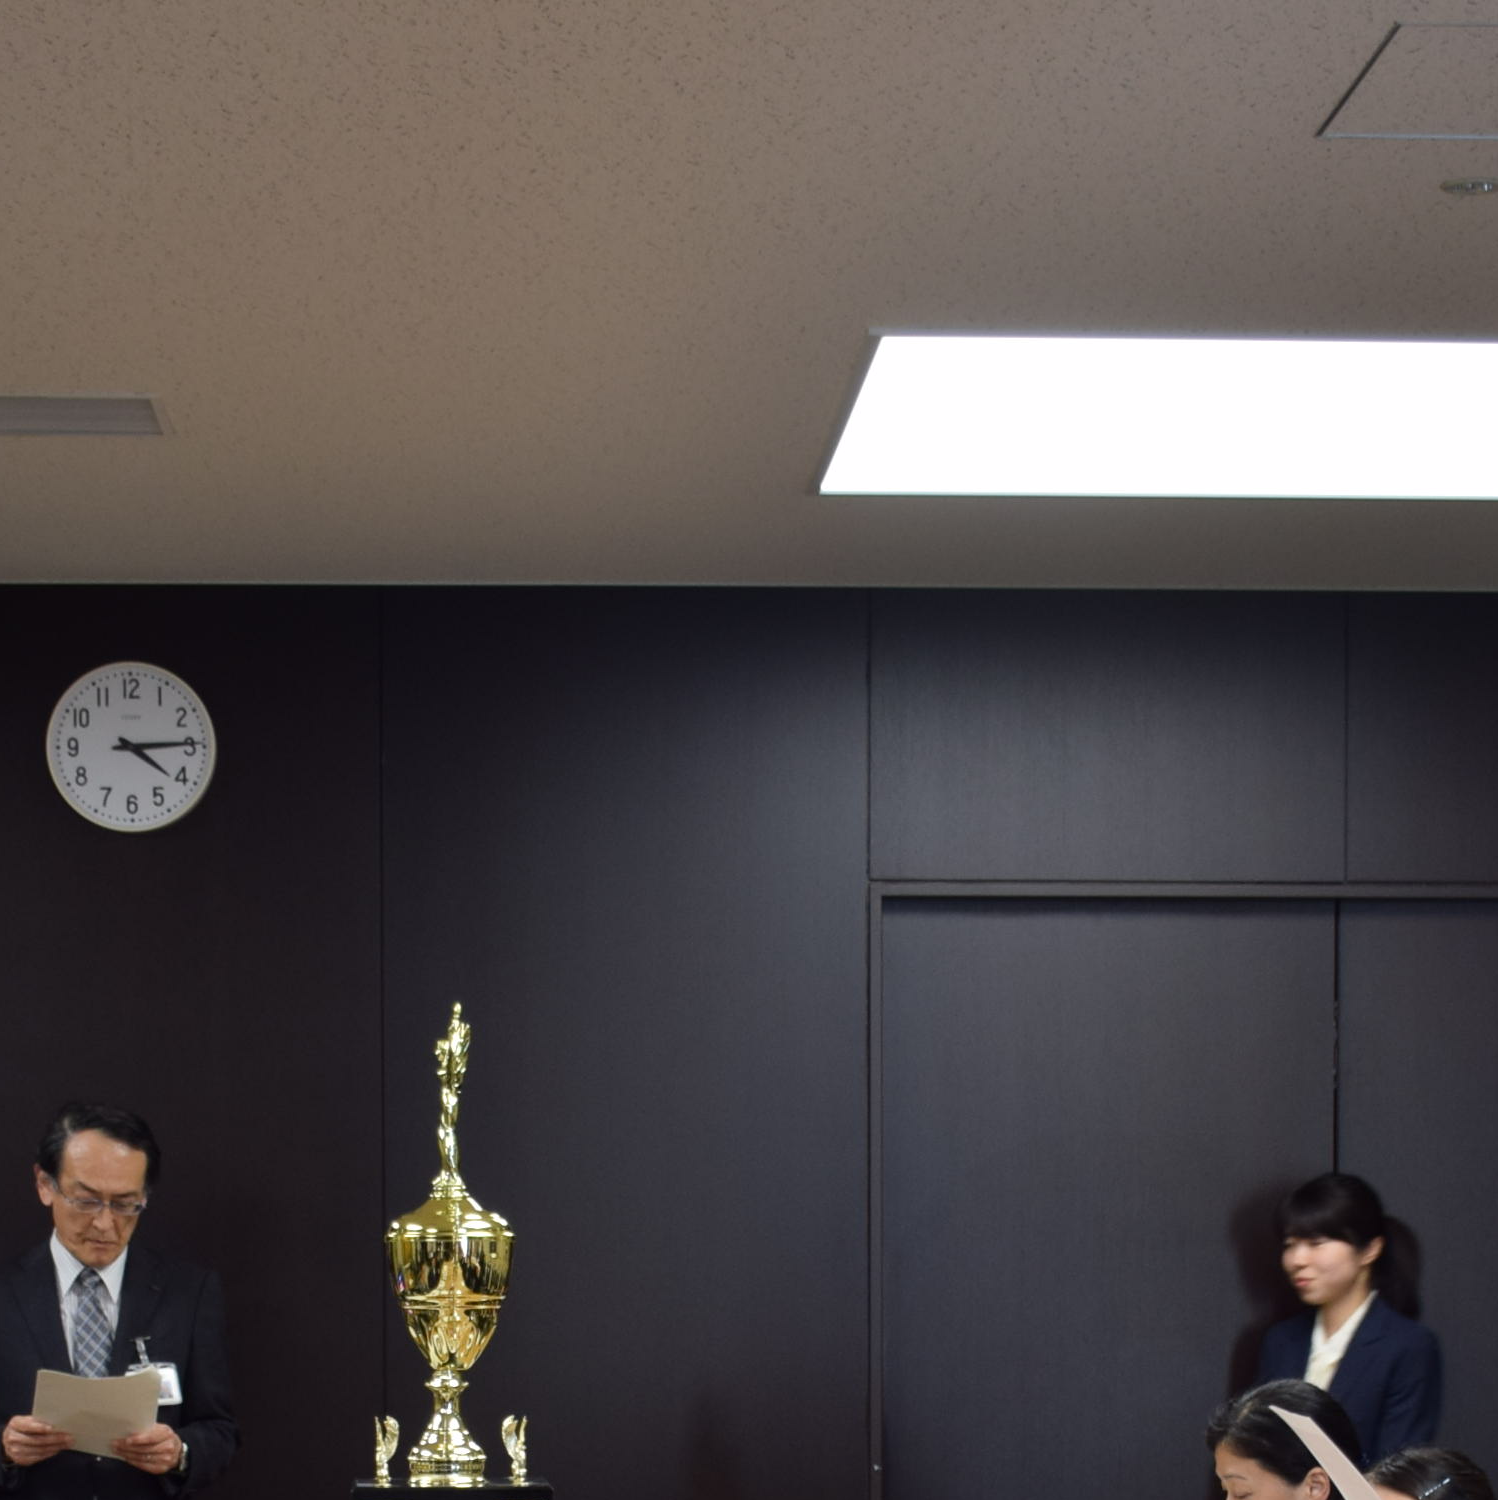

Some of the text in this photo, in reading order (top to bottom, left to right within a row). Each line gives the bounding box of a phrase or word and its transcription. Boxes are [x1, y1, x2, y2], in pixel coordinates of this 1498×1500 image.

[97, 687, 109, 707] 11
[123, 679, 140, 699] 12
[73, 708, 89, 728] 10
[176, 707, 188, 728] 2
[67, 737, 79, 758] 9
[183, 736, 197, 757] 3
[75, 766, 88, 787] 8
[174, 766, 188, 786] 4
[100, 787, 112, 807] 7
[126, 794, 138, 815] 6
[153, 786, 164, 807] 5
